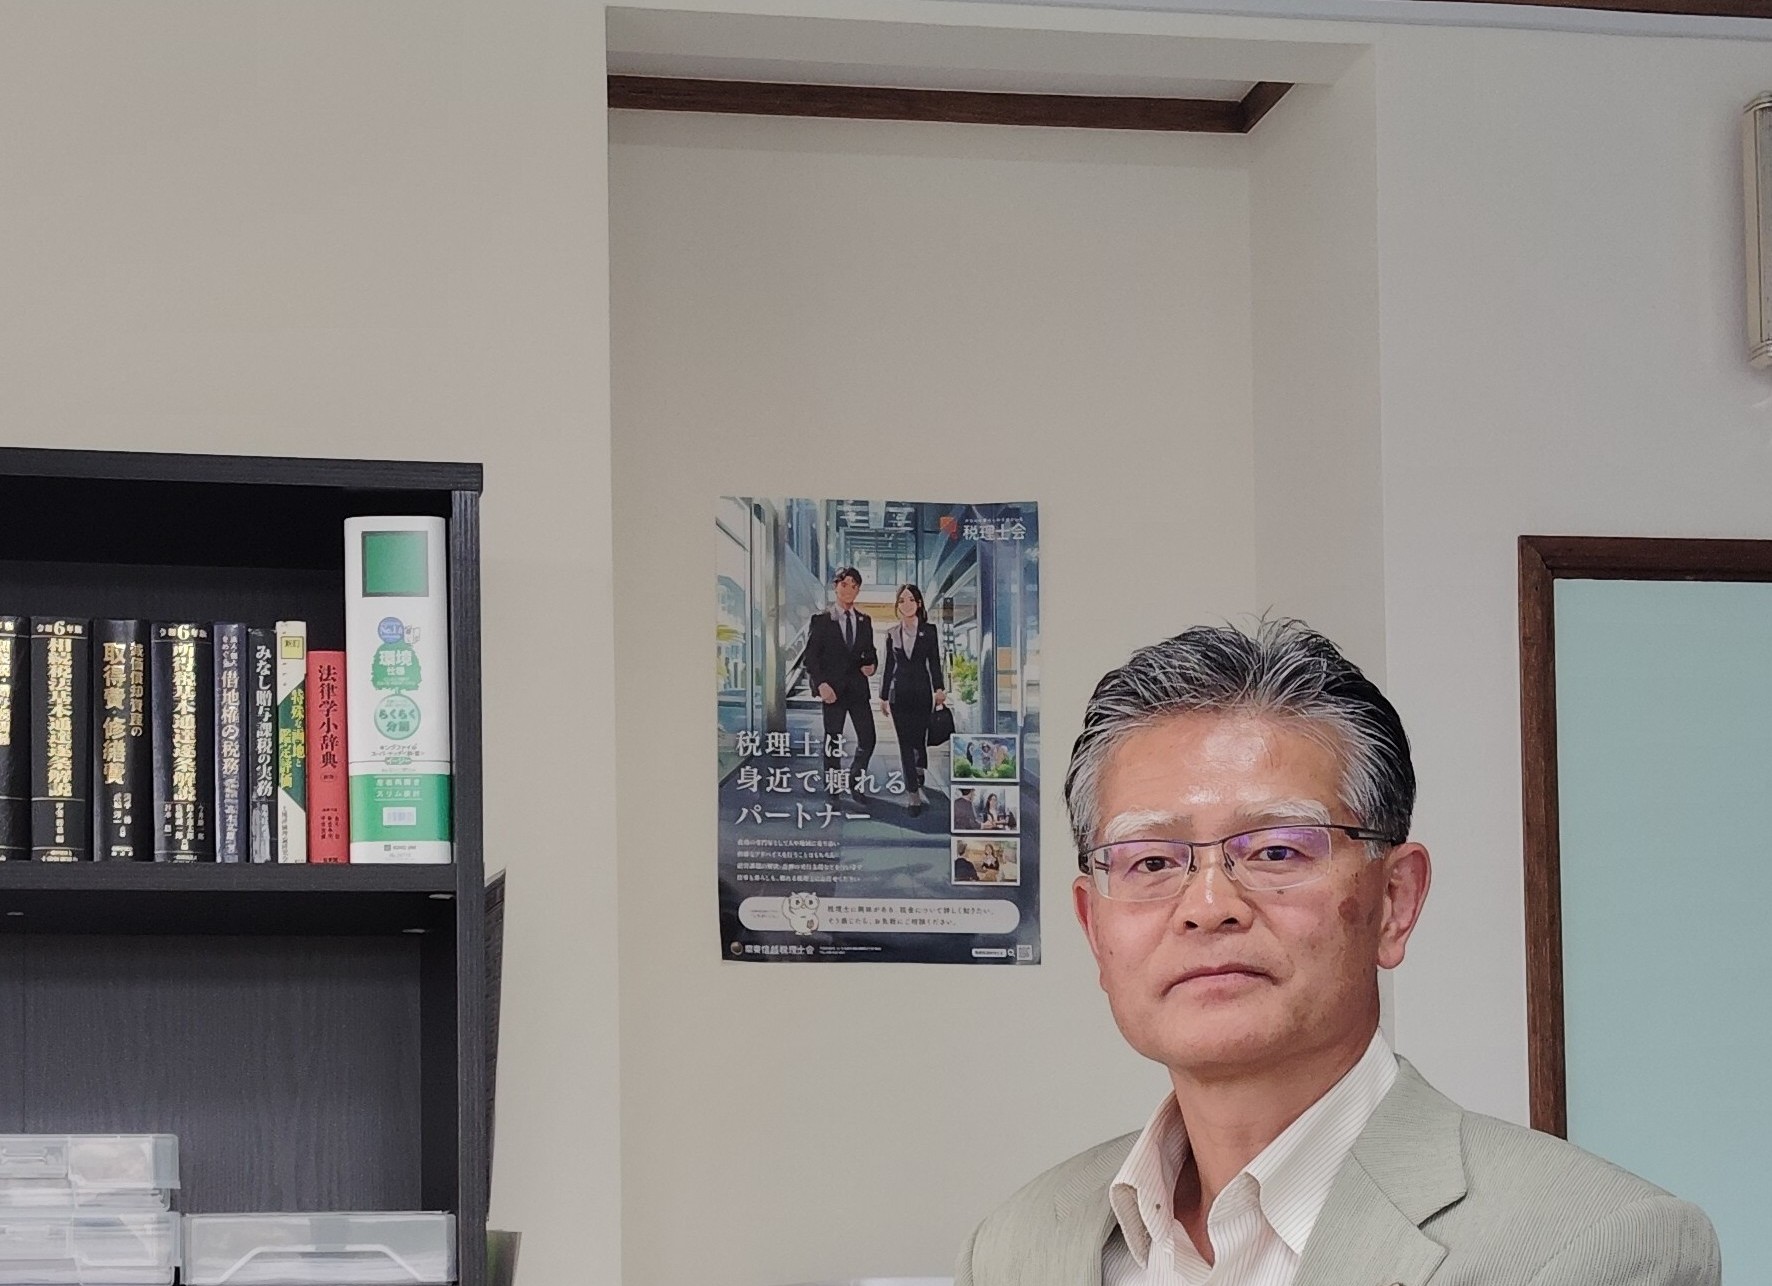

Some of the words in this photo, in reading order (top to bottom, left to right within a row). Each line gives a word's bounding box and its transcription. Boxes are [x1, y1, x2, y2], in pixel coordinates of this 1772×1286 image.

[963, 523, 1027, 540] 税理士会
[221, 670, 240, 775] 借地権の税務
[255, 645, 273, 797] みなし贈与課税の実務
[318, 664, 340, 769] 法律学小辞典
[736, 730, 849, 758] 税理士は
[736, 766, 906, 795] 身近で頼れる
[735, 802, 871, 829] パートナー
